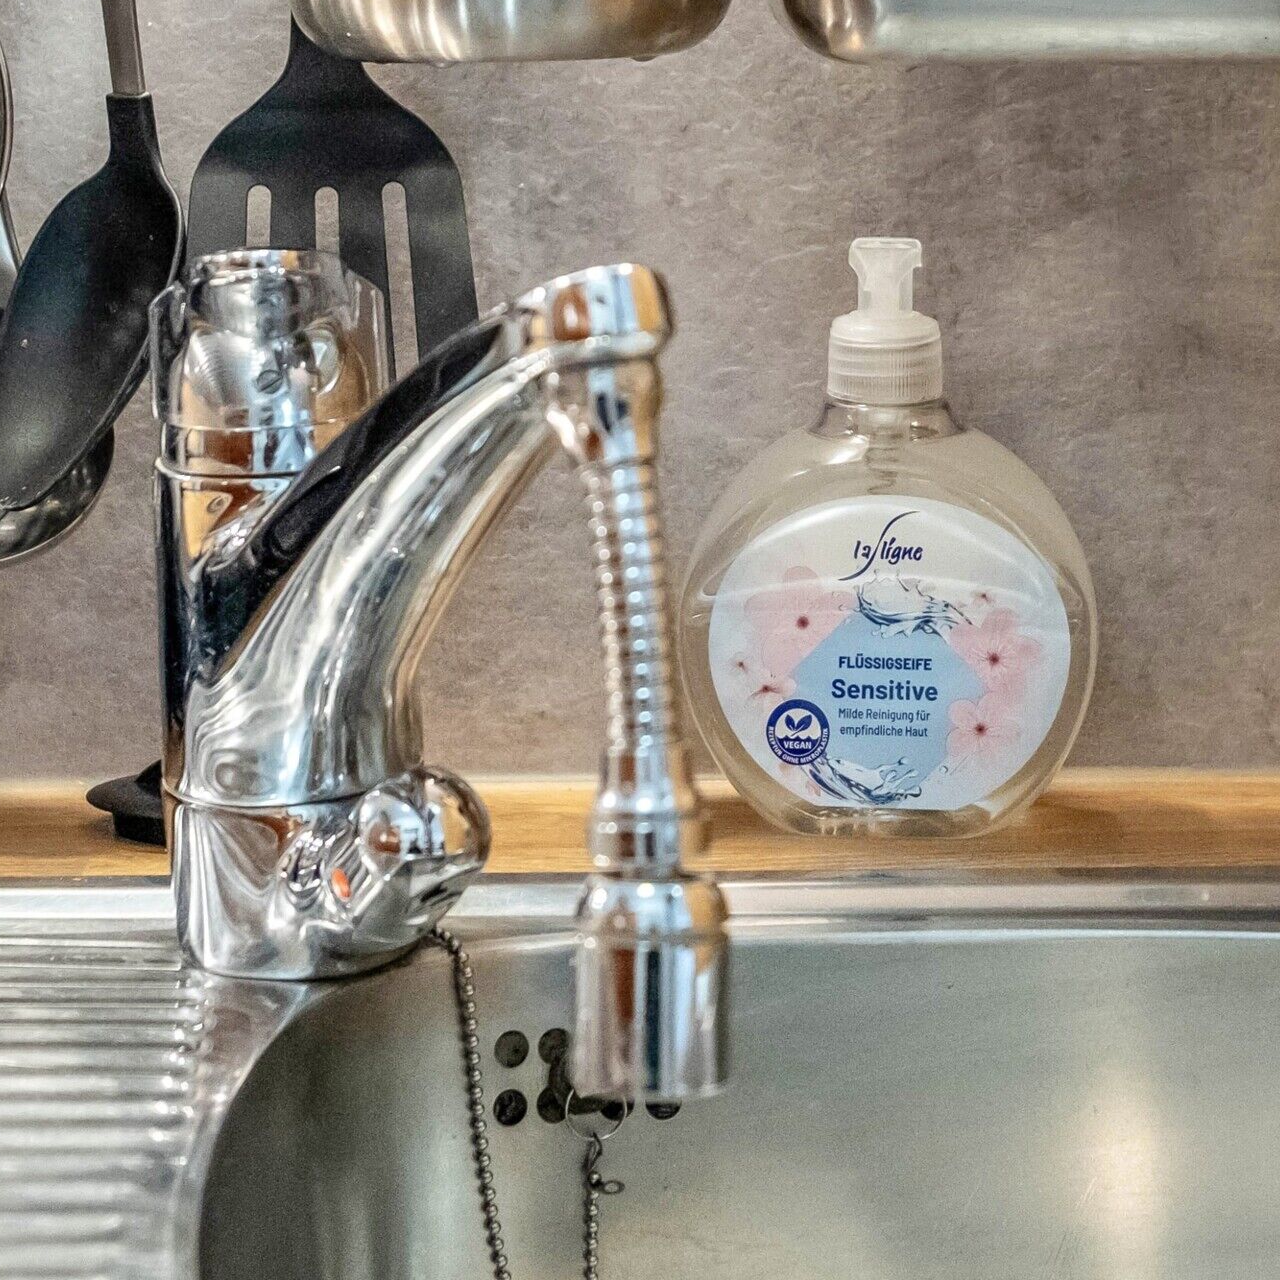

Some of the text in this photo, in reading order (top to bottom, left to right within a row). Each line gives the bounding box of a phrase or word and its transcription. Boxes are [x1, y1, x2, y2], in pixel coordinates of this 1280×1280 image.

[853, 537, 924, 565] la ligne
[838, 653, 933, 671] FLÜSSIGSEIFE
[831, 678, 939, 701] Sensitive
[838, 707, 931, 724] Milde Reinigung für
[839, 724, 928, 739] empfindliche Haut
[783, 740, 812, 750] VEGAN
